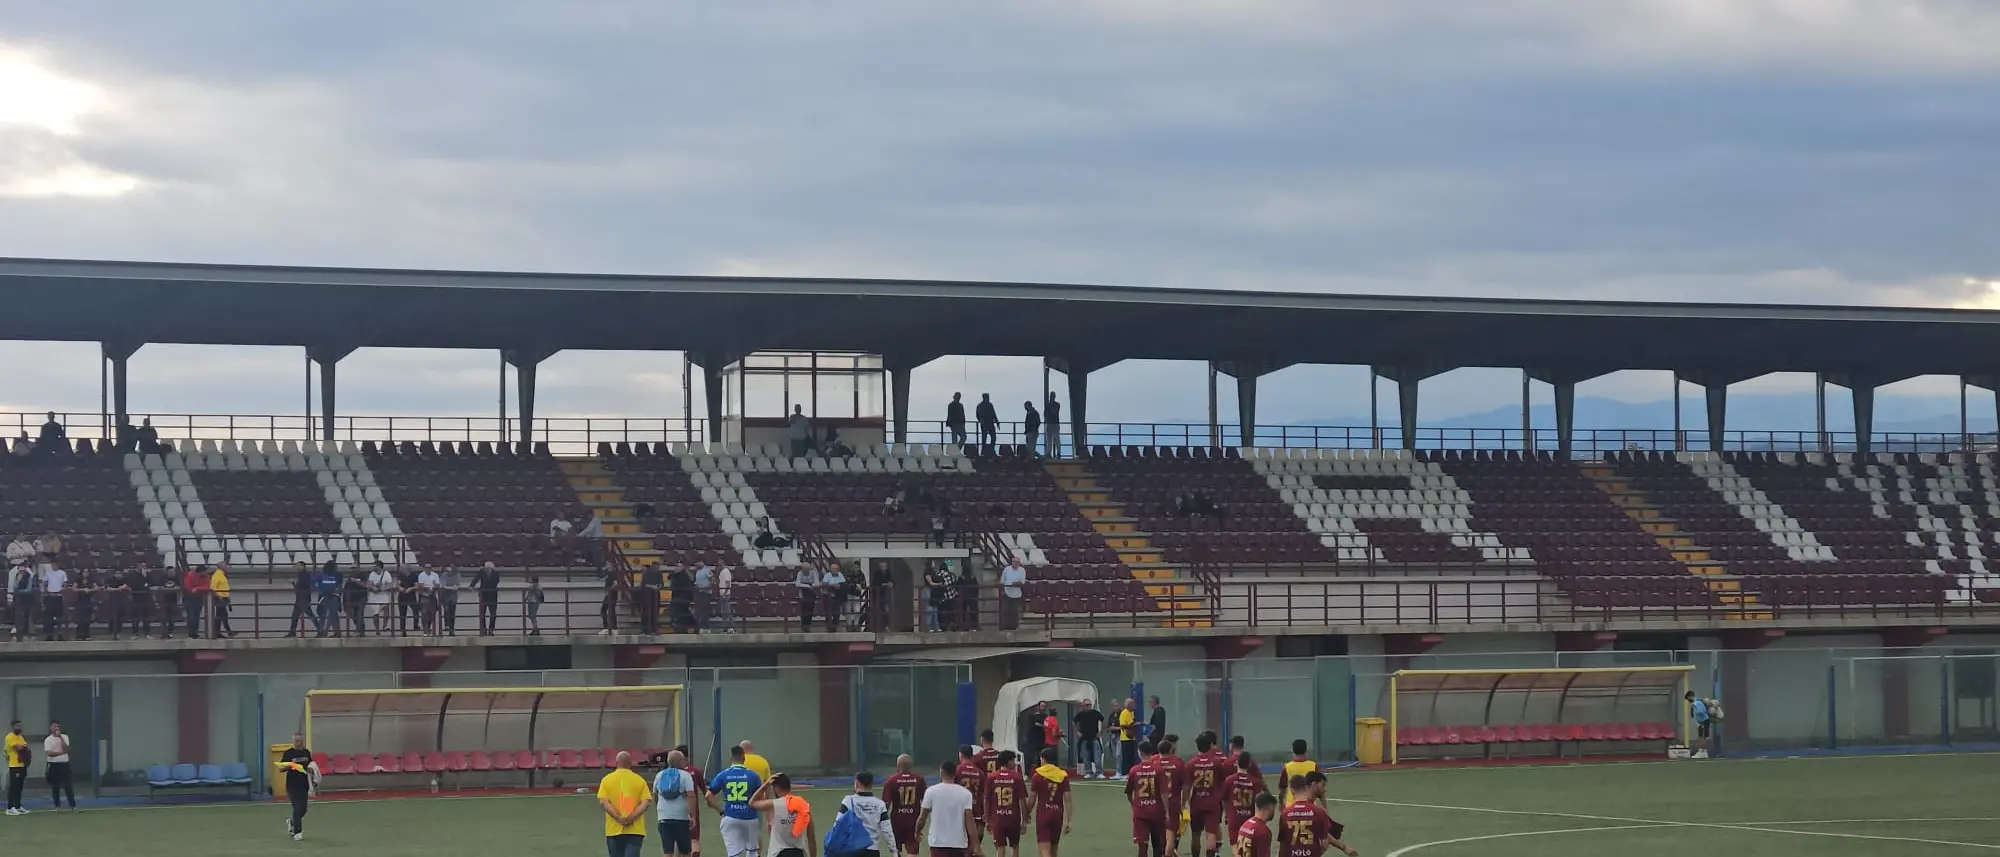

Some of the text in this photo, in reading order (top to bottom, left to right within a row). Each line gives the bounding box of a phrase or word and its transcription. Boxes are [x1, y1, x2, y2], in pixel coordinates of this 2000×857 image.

[726, 781, 748, 802] 32
[898, 786, 916, 805] 10
[1138, 777, 1155, 797] 21
[1287, 820, 1313, 845] 75
